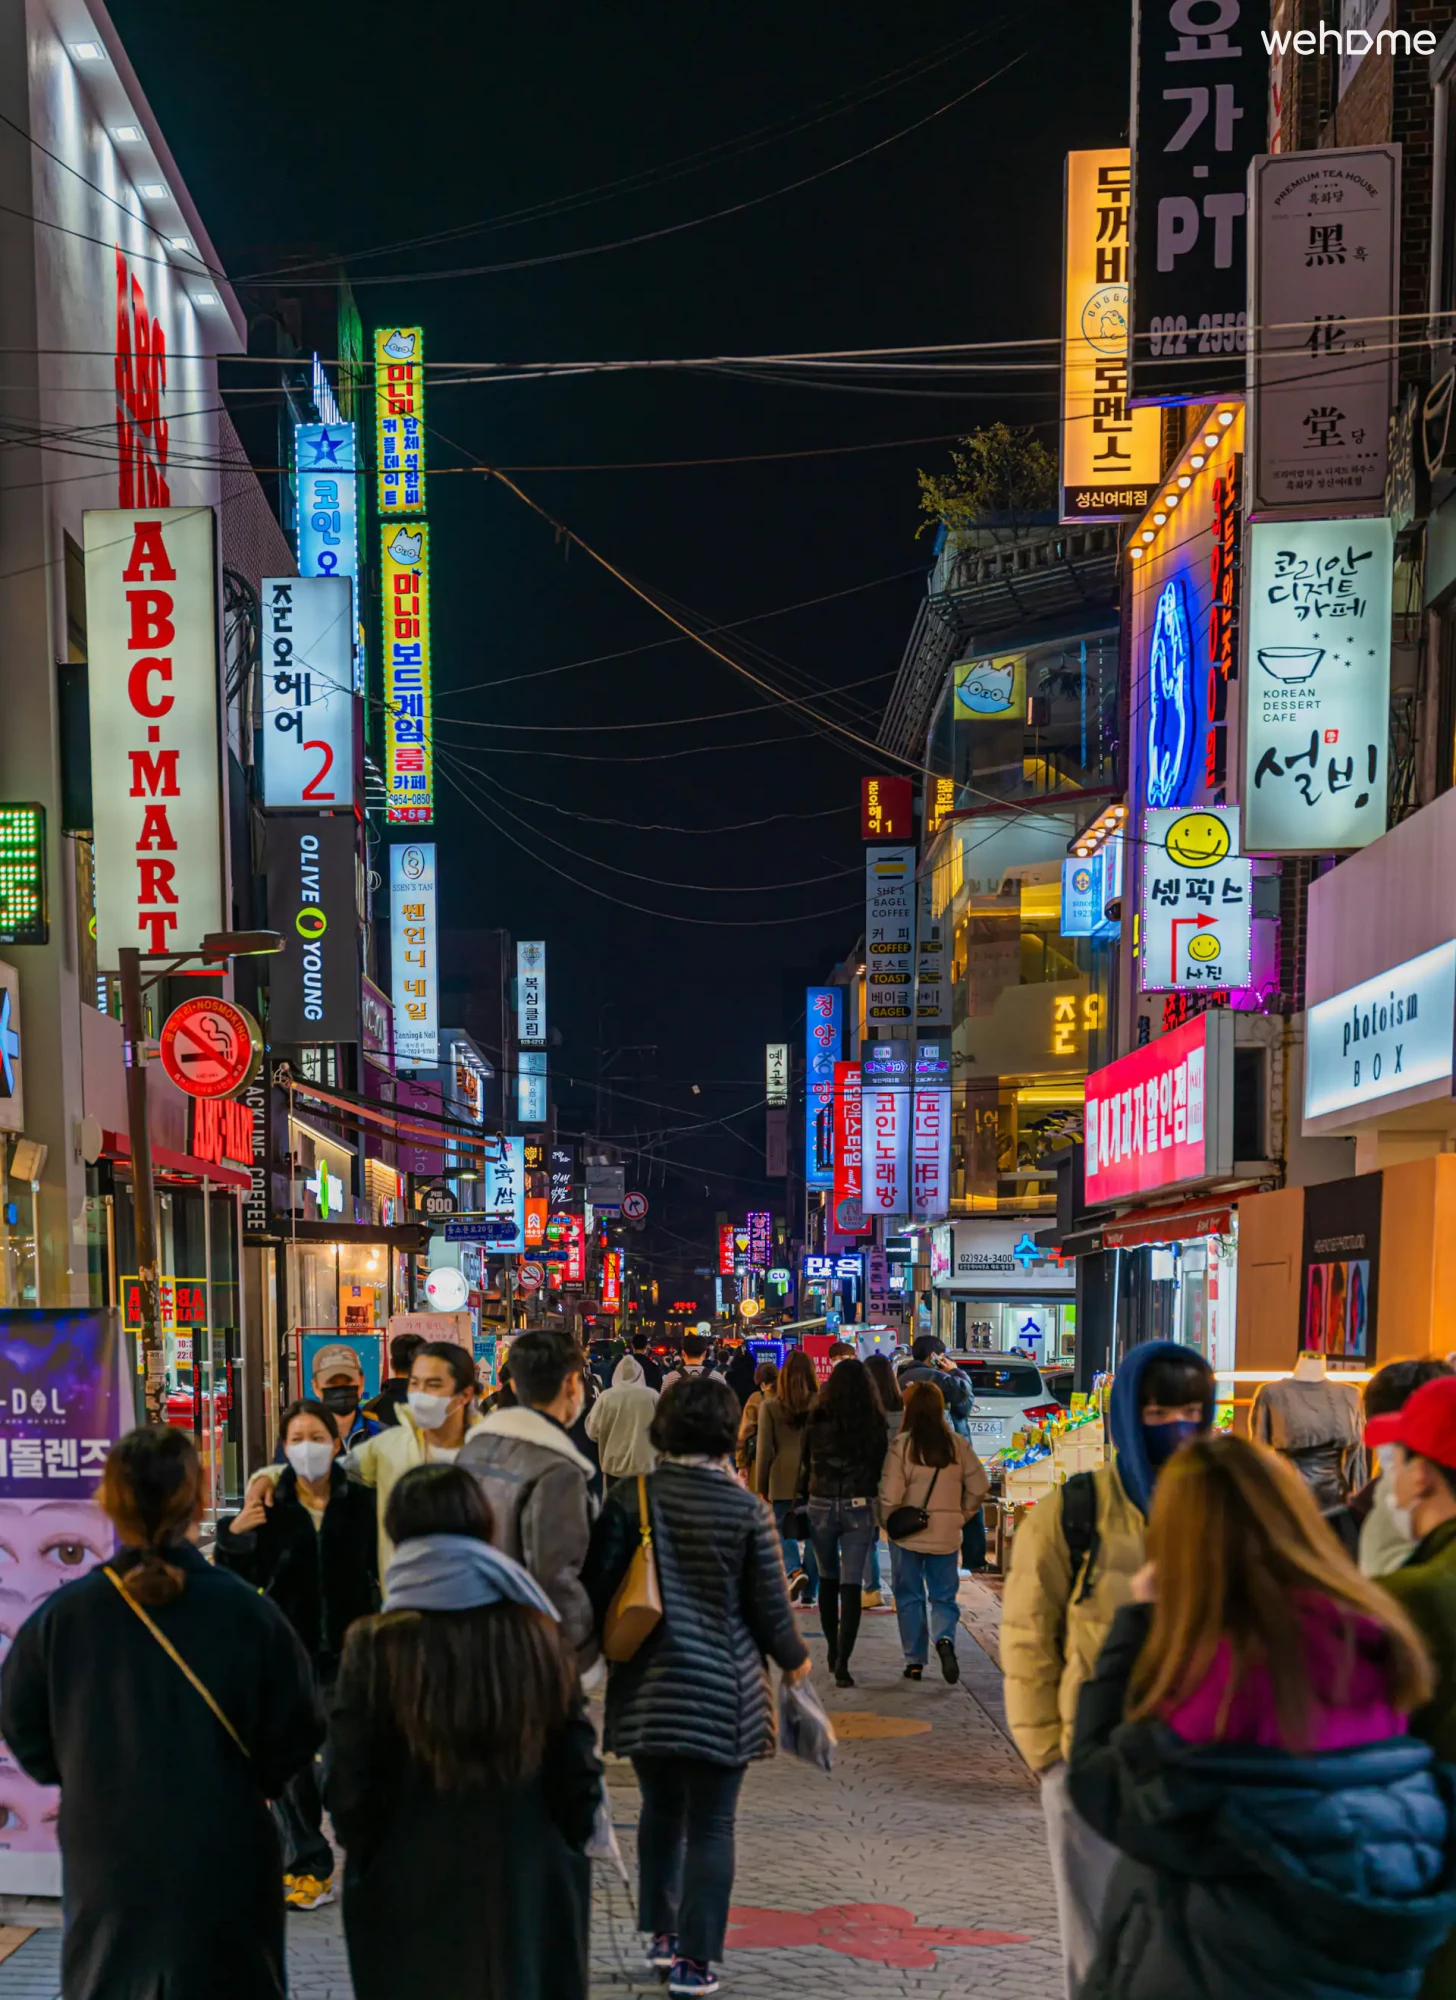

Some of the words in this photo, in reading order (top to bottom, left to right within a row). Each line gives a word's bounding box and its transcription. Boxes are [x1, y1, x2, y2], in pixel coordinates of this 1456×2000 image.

[1274, 172, 1320, 206] PREMIUM
[1322, 170, 1343, 178] TEA
[1345, 172, 1379, 199] HOUSE
[387, 365, 414, 415] 미니미
[382, 418, 400, 506] 커플데이트
[1076, 490, 1147, 508] 성신여대점
[311, 480, 341, 546] 코인
[1274, 547, 1373, 580] 코리안
[1268, 580, 1357, 604] 디저트
[393, 573, 420, 639] 미니미
[1294, 598, 1366, 621] 카페
[273, 584, 311, 744] 준오헤어
[1263, 689, 1316, 699] KOREAN
[1263, 700, 1321, 711] DESSERT
[1263, 713, 1297, 722] CAFE
[122, 521, 182, 956] ABC-MART
[302, 740, 335, 801] 2
[393, 774, 427, 790] 카페
[868, 781, 882, 833] 준오헤어
[885, 820, 893, 833] 1
[299, 834, 320, 904] OLIVE
[392, 883, 415, 892] SSEN'S
[417, 883, 433, 891] TAN
[877, 886, 905, 895] SHE'S
[872, 909, 910, 918] COFFEE
[874, 897, 908, 907] BAGEL
[401, 903, 426, 968] 쎈언니
[871, 943, 909, 953] COFFEE
[872, 960, 909, 972] 토스트
[1186, 965, 1223, 981] 사진
[302, 942, 323, 1022] YOUNG
[874, 974, 906, 984] TOAST
[404, 979, 427, 1021] 네일
[524, 977, 540, 1037] 복싱클럽
[871, 991, 909, 1004] 베이글
[196, 1000, 248, 1042] NOSMOKING
[873, 1007, 907, 1017] BAGEL
[1343, 991, 1419, 1056] photoism
[1099, 1061, 1188, 1168] 세계과자할인점
[875, 1093, 898, 1208] 코인노래방
[247, 1167, 266, 1230] COFFEE
[427, 1198, 452, 1213] 900
[807, 1257, 862, 1277] 많은
[960, 1254, 1013, 1264] 02)924-3400
